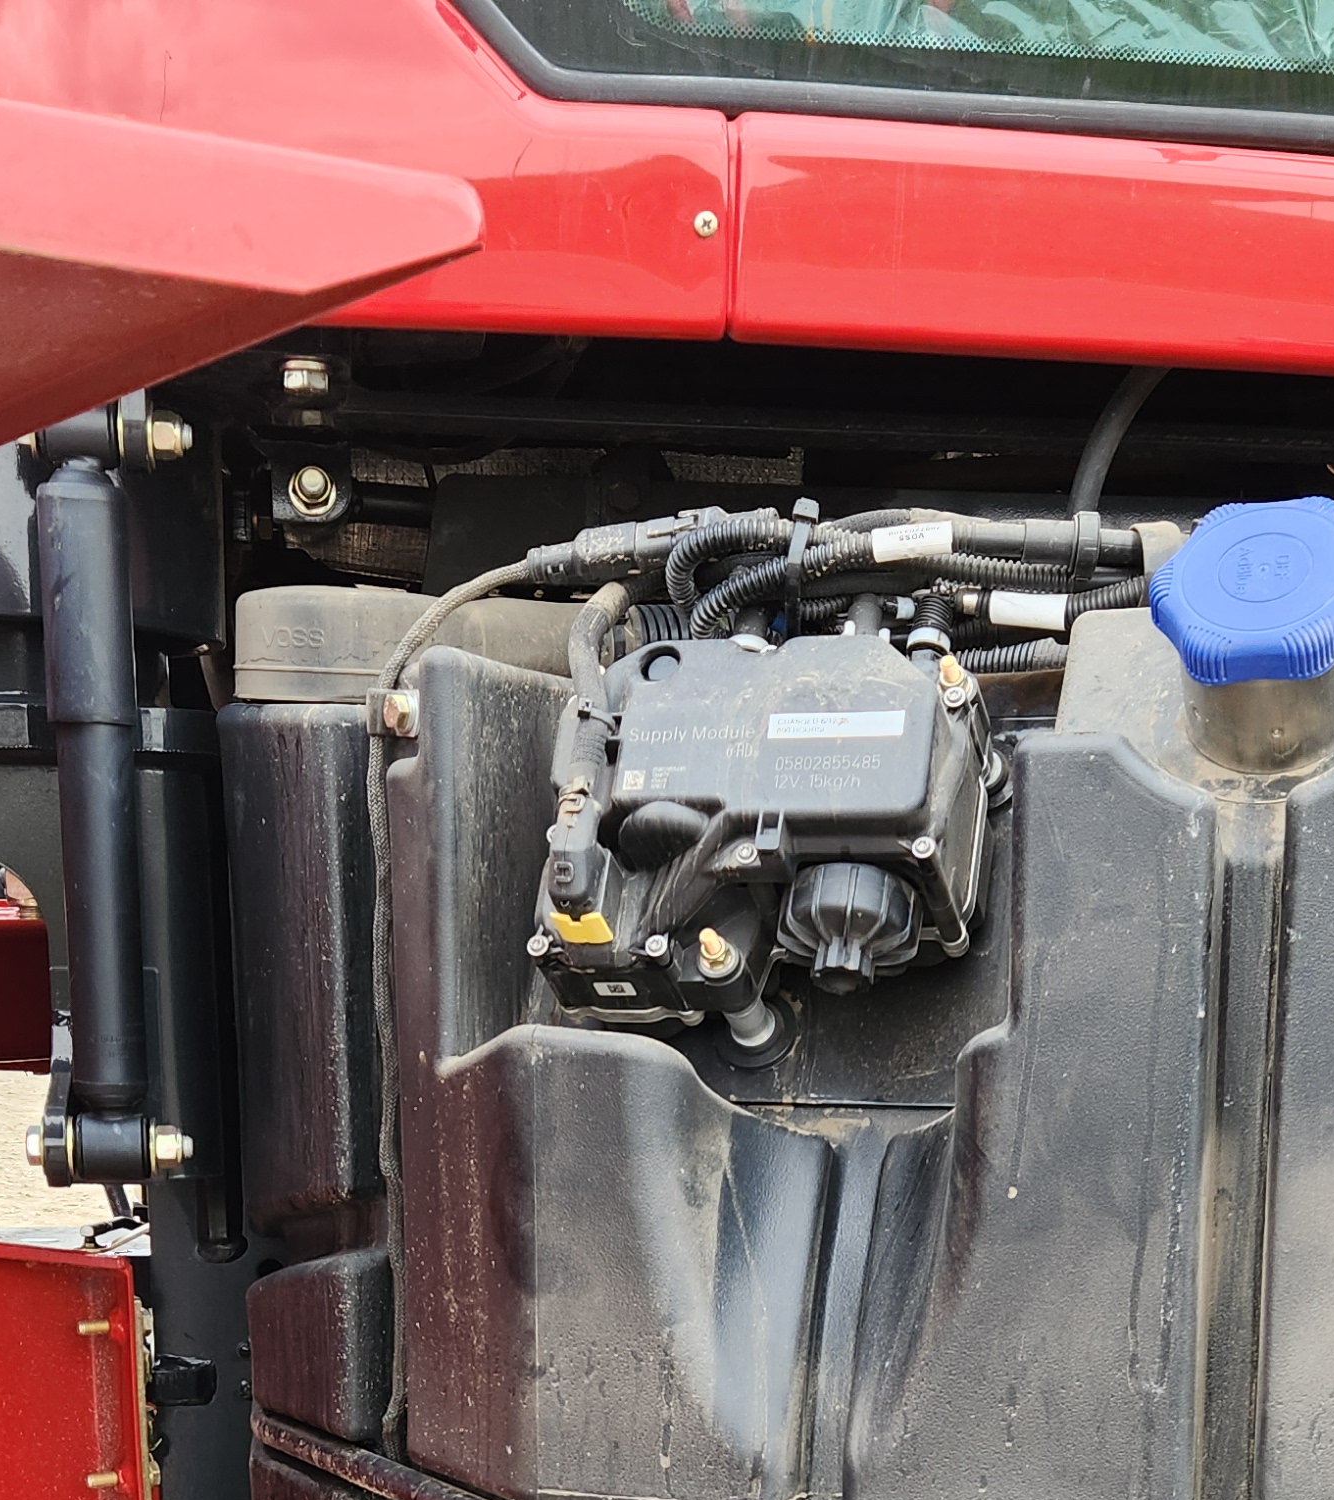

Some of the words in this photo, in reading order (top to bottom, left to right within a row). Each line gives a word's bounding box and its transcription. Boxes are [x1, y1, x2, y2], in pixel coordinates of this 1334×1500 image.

[261, 627, 325, 649] VOSS
[628, 726, 688, 745] Supply
[692, 724, 756, 741] Module
[775, 754, 881, 771] 05802855485
[810, 773, 861, 792] 15kg/h
